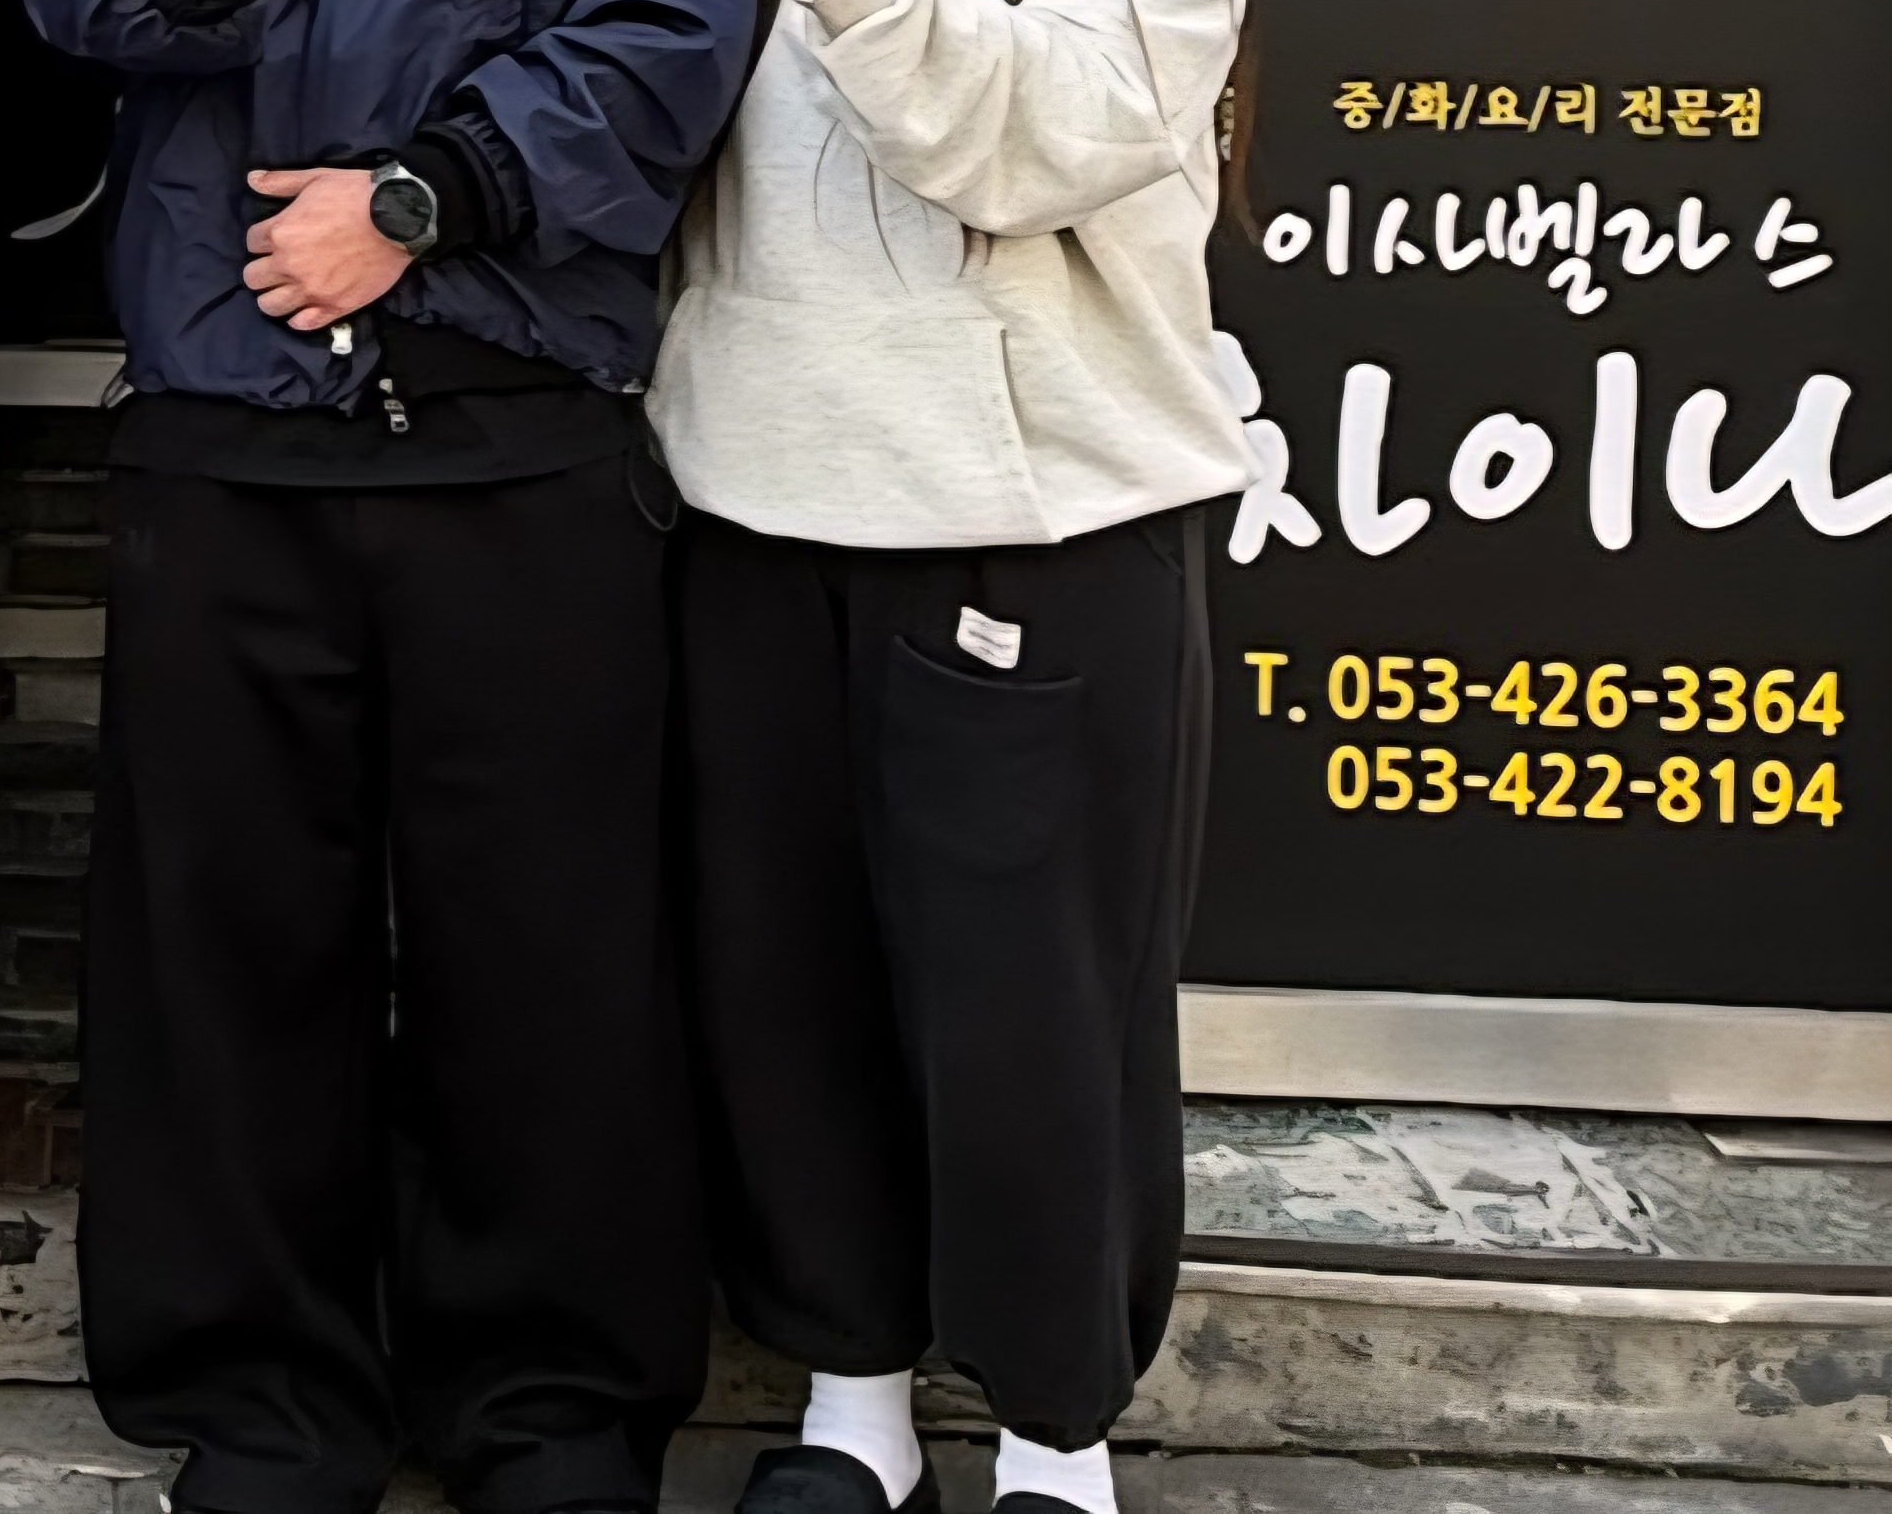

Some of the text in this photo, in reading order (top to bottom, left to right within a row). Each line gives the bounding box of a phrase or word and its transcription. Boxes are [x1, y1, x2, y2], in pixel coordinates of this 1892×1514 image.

[1332, 81, 1762, 137] 중/화/요/리 전문점
[1244, 652, 1845, 737] T. 053-426-3364
[1326, 744, 1843, 828] 053-422-8194
